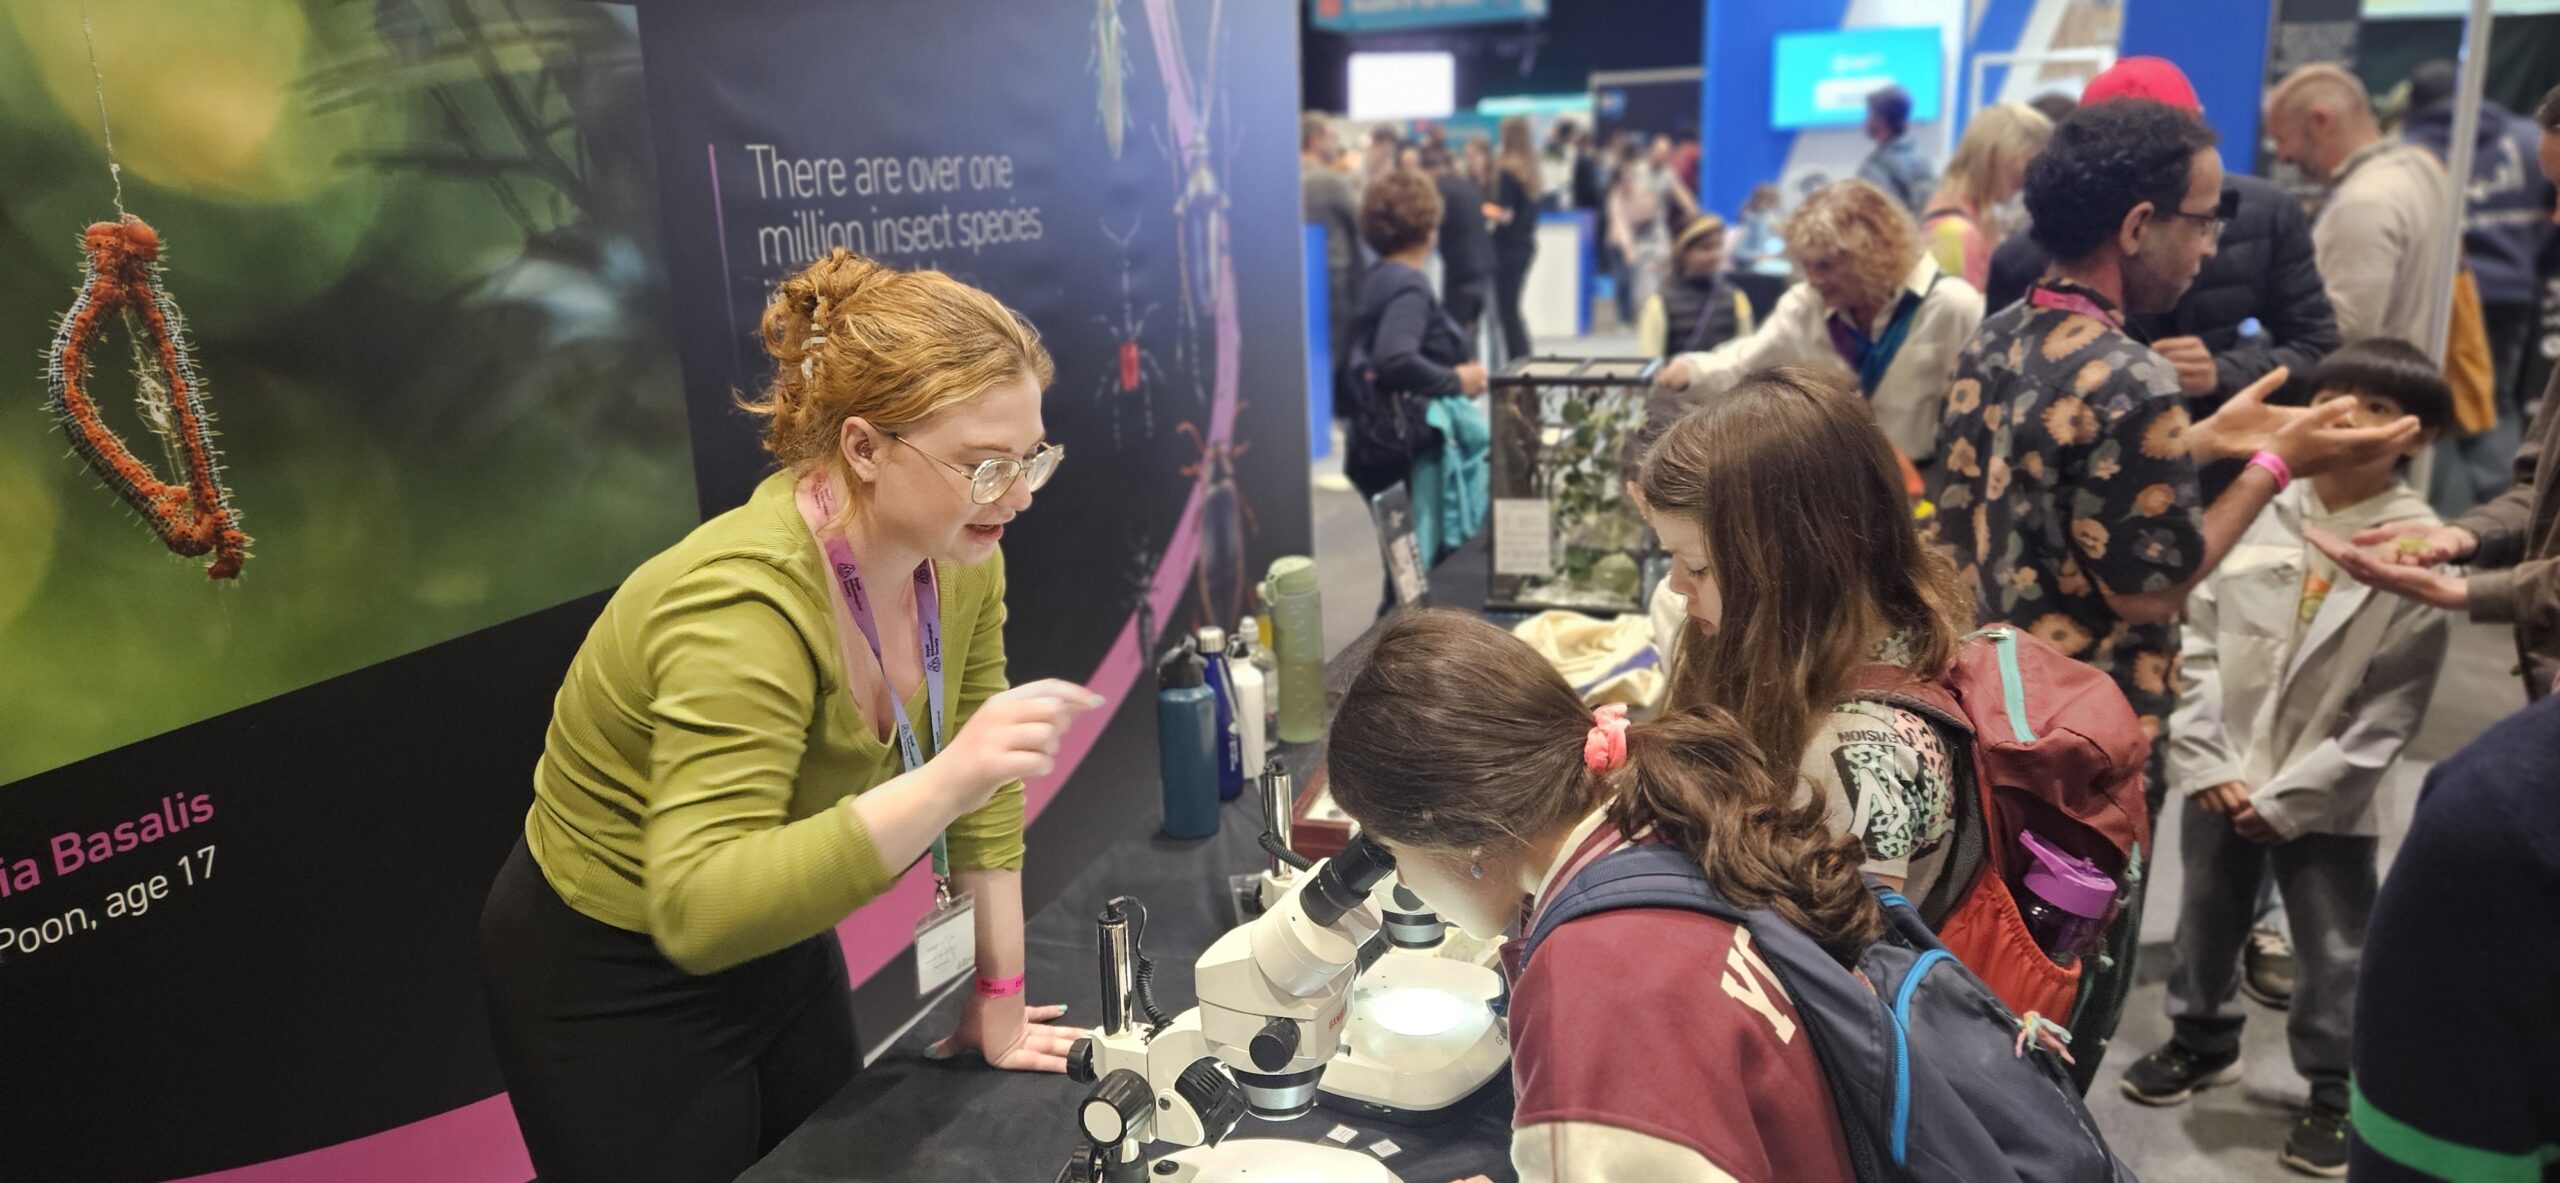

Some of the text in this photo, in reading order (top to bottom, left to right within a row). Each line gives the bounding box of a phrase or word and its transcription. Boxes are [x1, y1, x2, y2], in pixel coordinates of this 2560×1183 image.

[745, 144, 1013, 200] There are over one
[758, 198, 1043, 267] million insect species
[51, 791, 214, 876] Basalis
[0, 845, 215, 953] Poon, age 17
